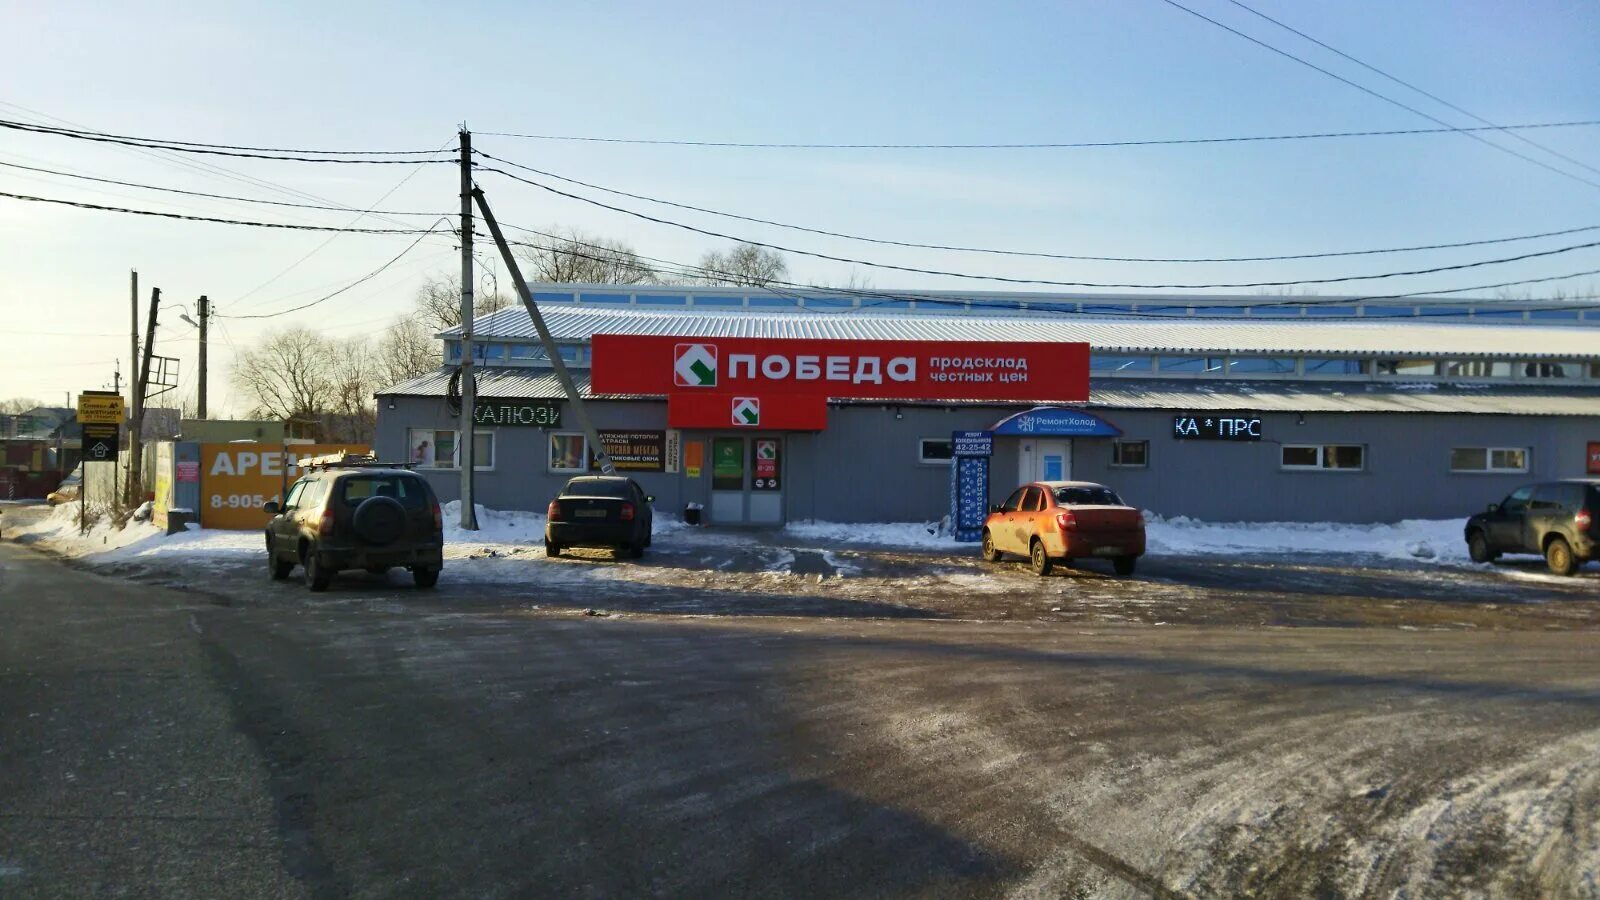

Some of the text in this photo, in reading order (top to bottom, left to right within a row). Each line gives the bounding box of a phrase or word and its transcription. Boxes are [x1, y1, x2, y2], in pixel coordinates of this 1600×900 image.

[930, 356, 1027, 371] продсклад
[930, 372, 1028, 384] честных цен
[1036, 417, 1096, 427] РемонтХолод
[1175, 418, 1199, 435] КА
[955, 443, 991, 451] 42-25-42
